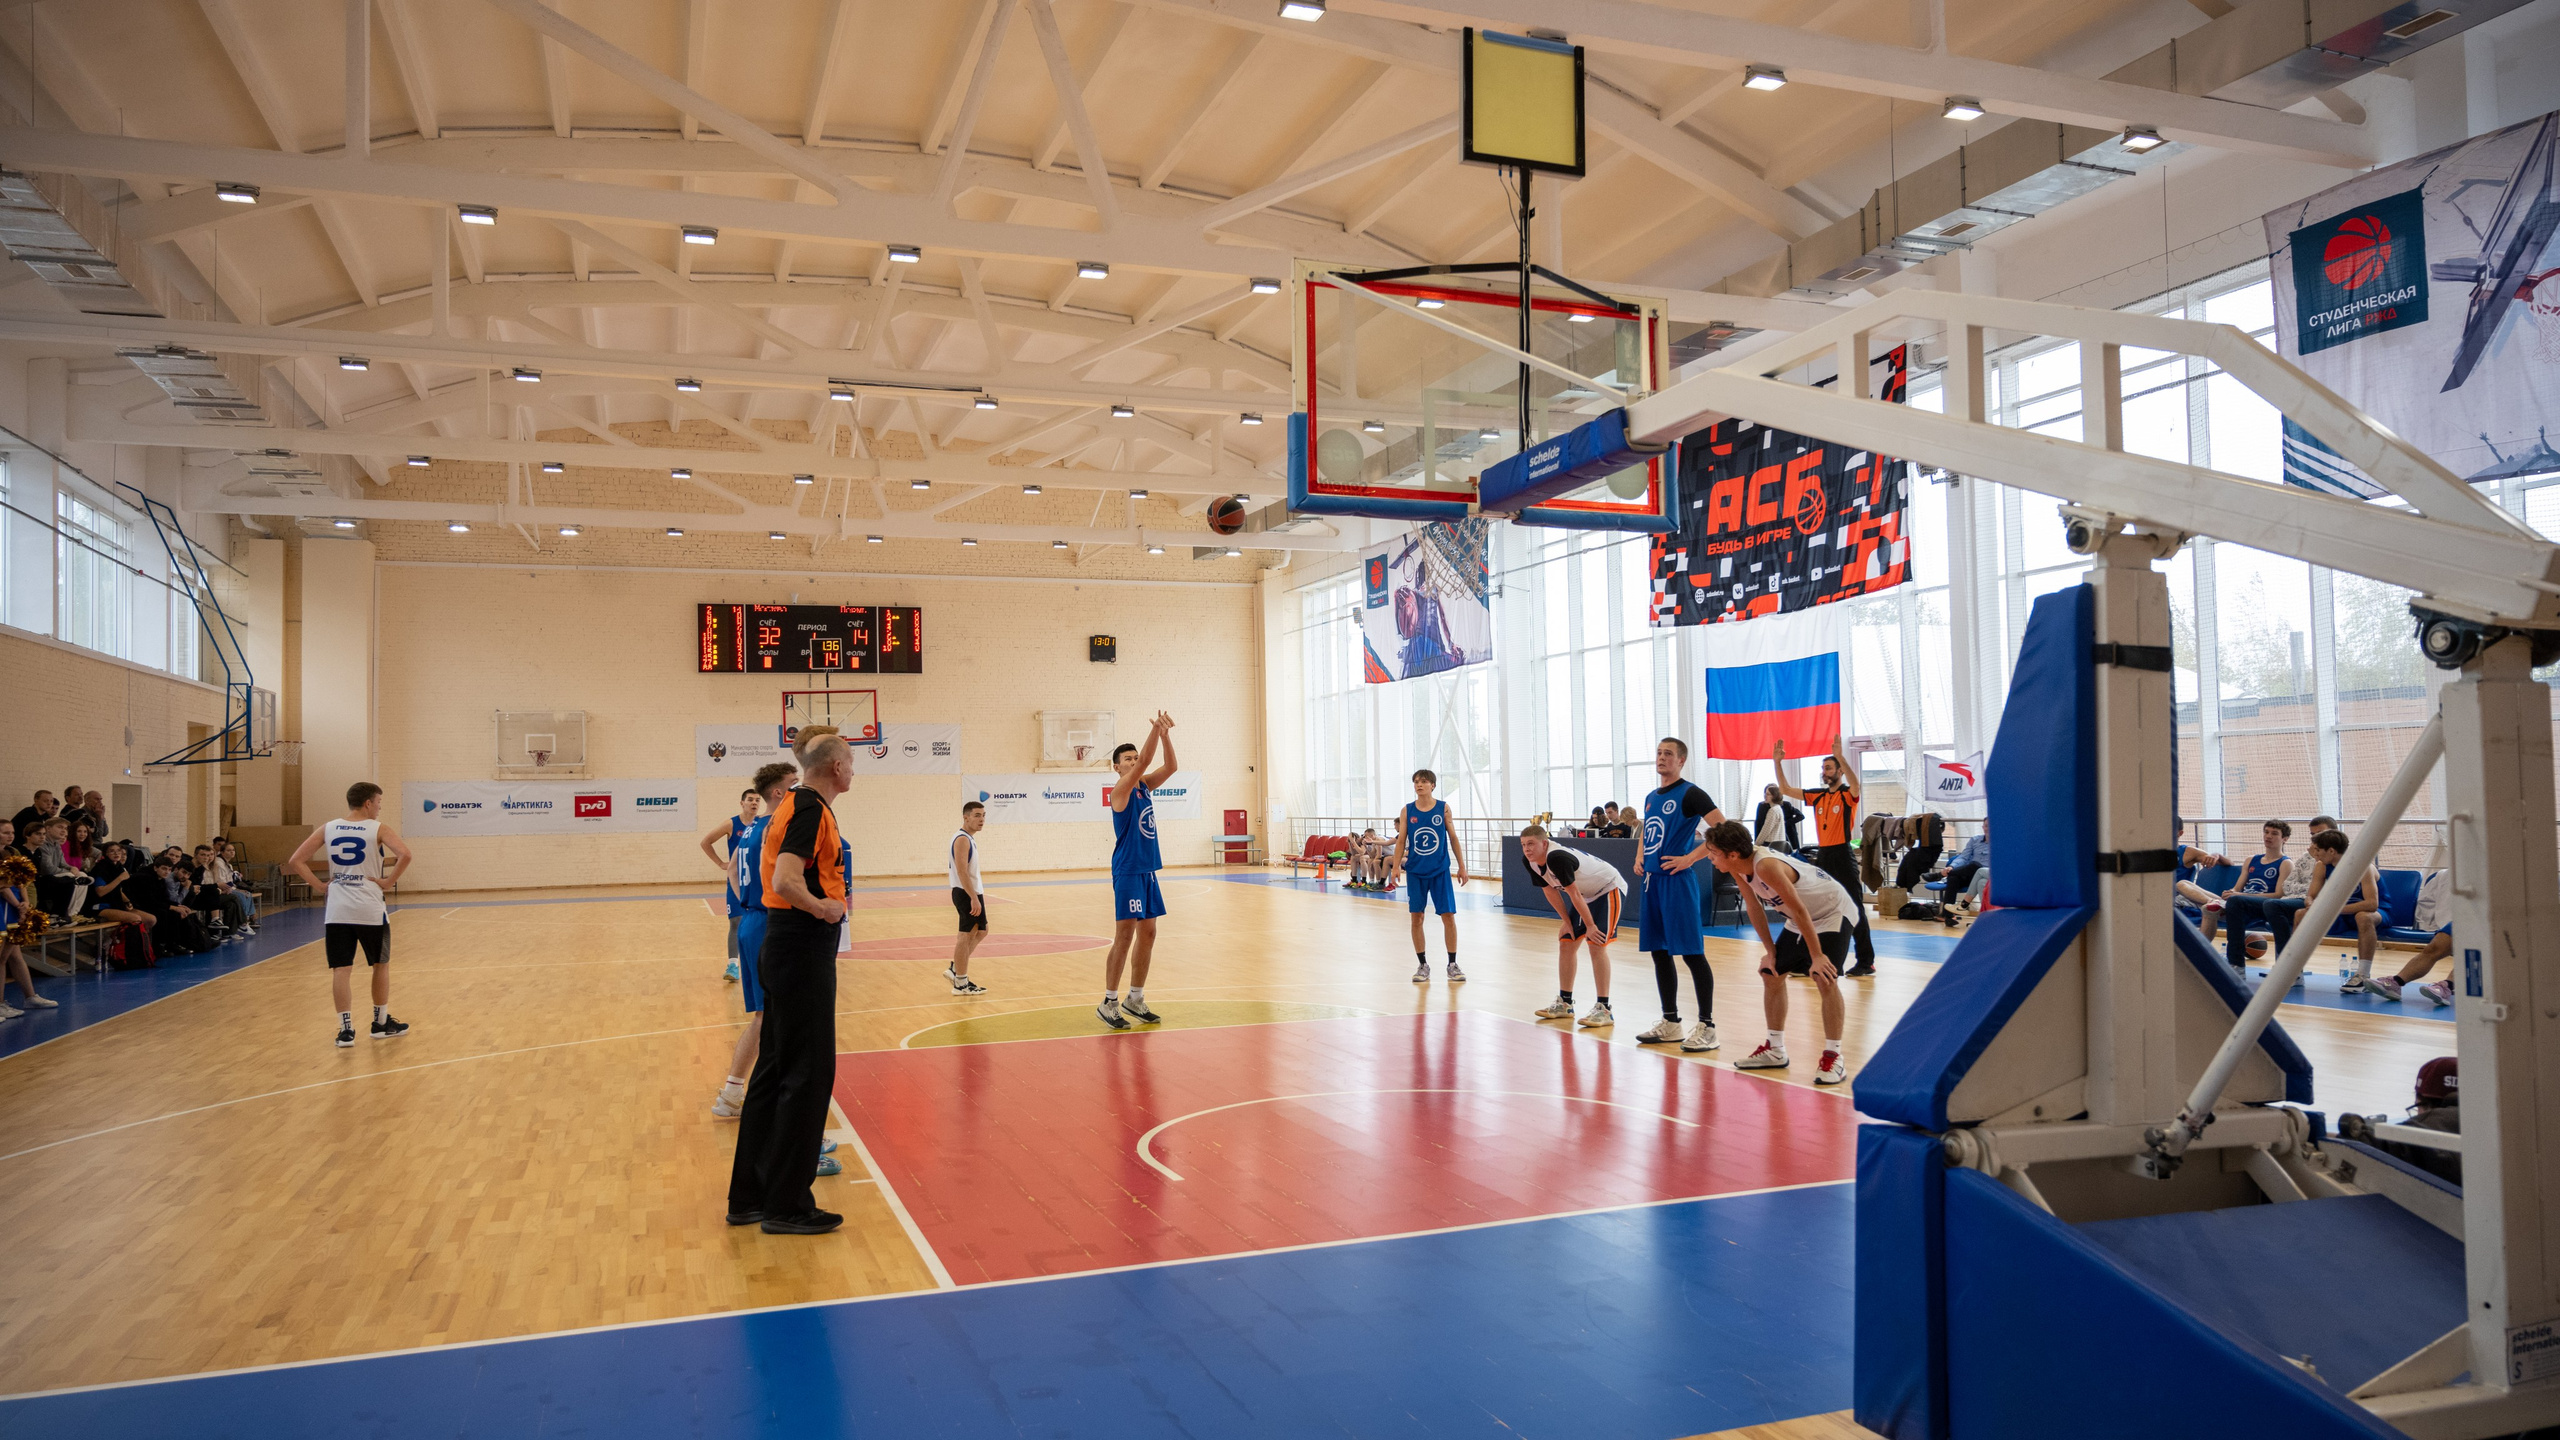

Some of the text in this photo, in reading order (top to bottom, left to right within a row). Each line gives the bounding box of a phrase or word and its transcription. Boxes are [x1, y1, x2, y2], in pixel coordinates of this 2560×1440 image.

[2308, 285, 2417, 328] СТУДЕНЧЕСКАЯ
[2326, 308, 2398, 338] ЛИГА РЖД
[1529, 444, 1561, 468] schelde
[1528, 460, 1560, 480] international
[1707, 449, 1826, 535] АСБ
[1707, 526, 1792, 556] БУДЬ В ИГРЕ
[759, 618, 777, 627] СЧЁТ
[797, 624, 828, 632] ПЕРИОД
[847, 620, 864, 628] СЧЁТ
[759, 627, 781, 645] 32
[853, 629, 869, 645] 14
[825, 652, 839, 667] 14
[1938, 777, 1964, 791] ANTA
[1050, 791, 1085, 799] АРКТИКГАЗ
[1152, 788, 1187, 797] СИБУР
[511, 801, 553, 809] АРКТИКГАЗ
[636, 797, 678, 806] СИБУР
[1422, 834, 1429, 847] 2
[330, 836, 367, 866] 3
[1129, 899, 1143, 913] 88
